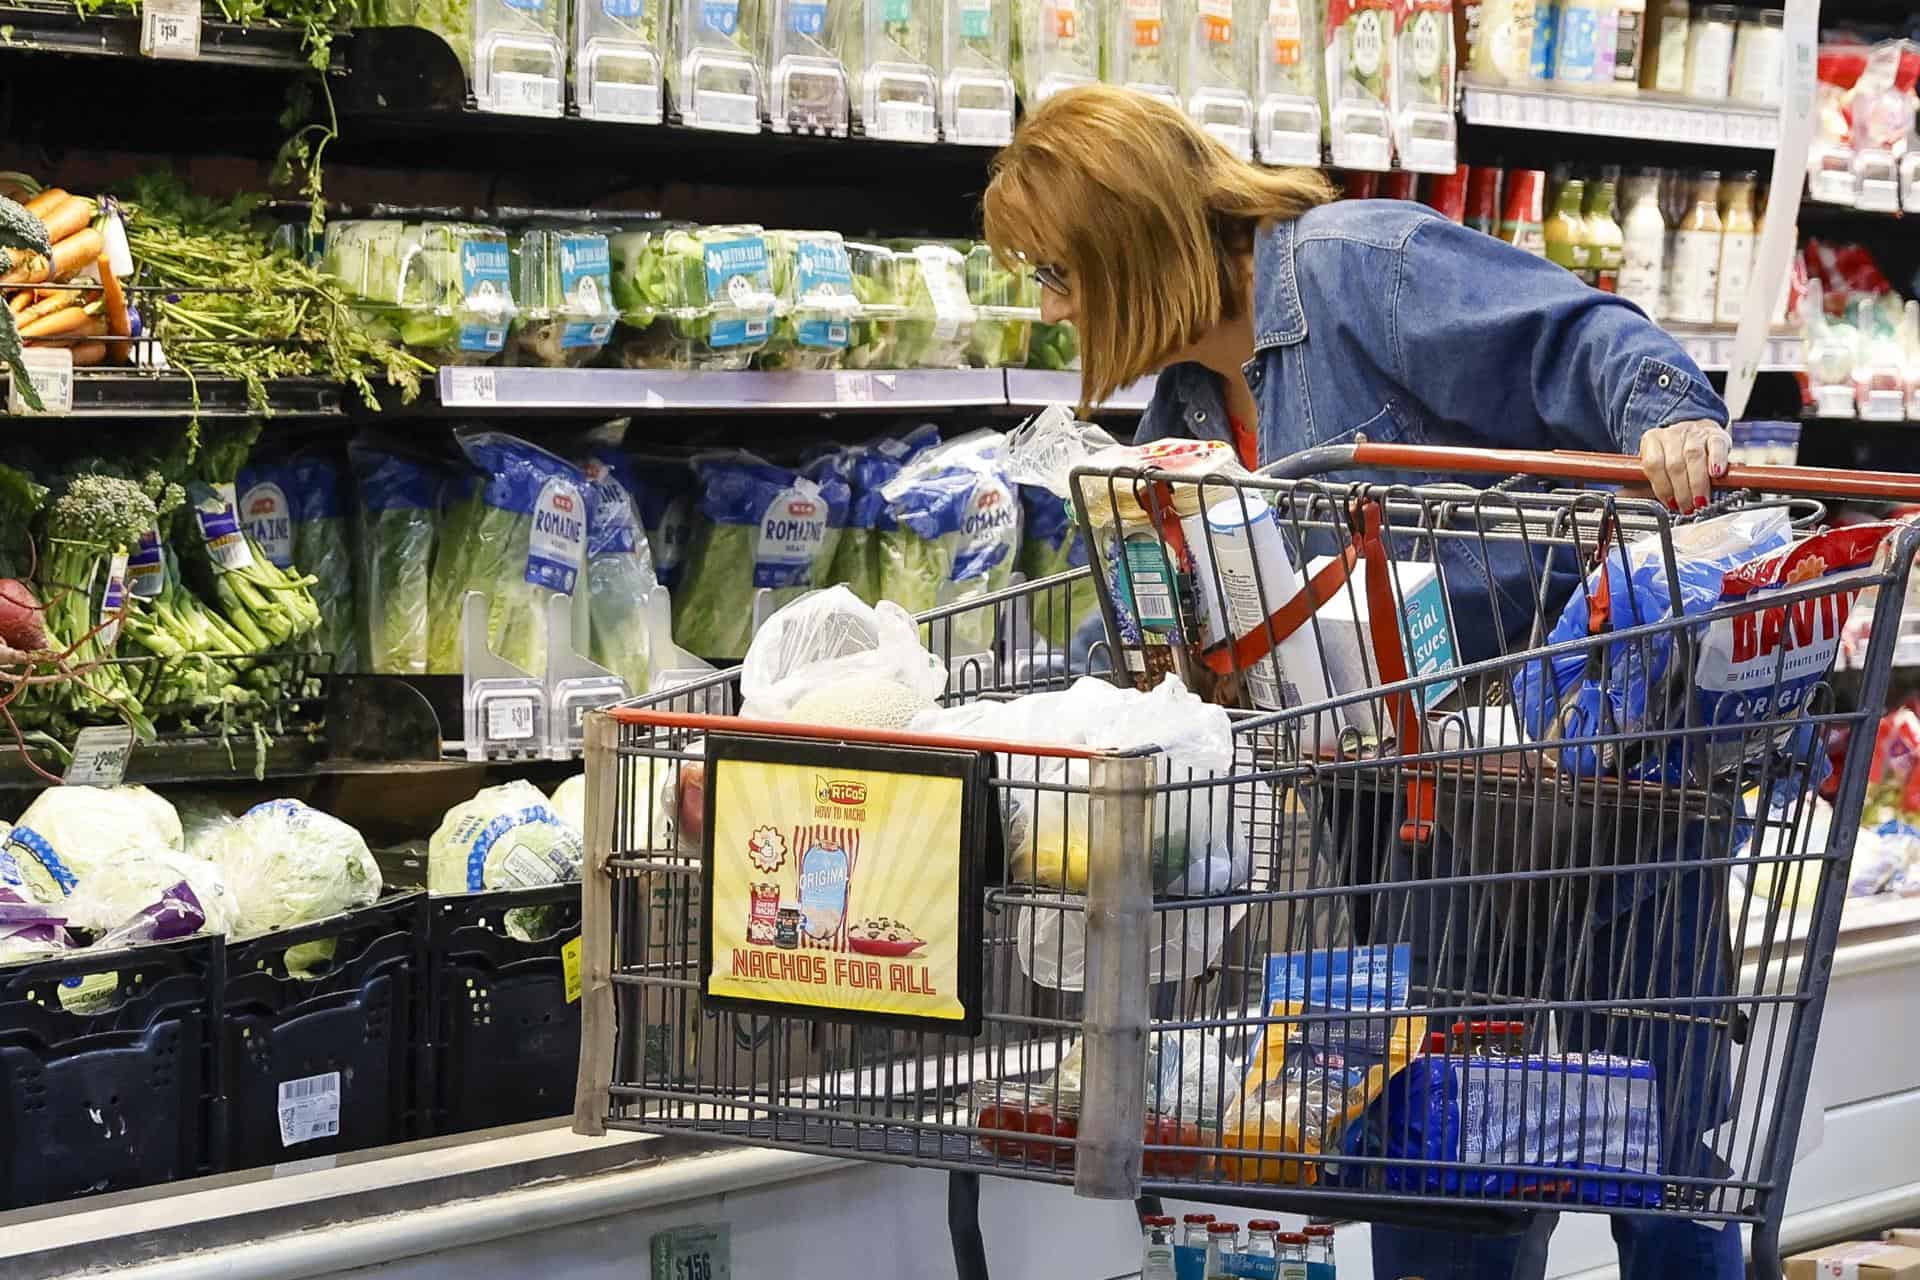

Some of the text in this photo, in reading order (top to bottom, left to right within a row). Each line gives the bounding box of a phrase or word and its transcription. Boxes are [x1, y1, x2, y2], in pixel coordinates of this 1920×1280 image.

[535, 509, 582, 543] ROMAINE
[766, 519, 824, 542] ROMAINE
[815, 804, 866, 822] HOW TO NACHO
[732, 948, 937, 996] NACHOS FOR ALL
